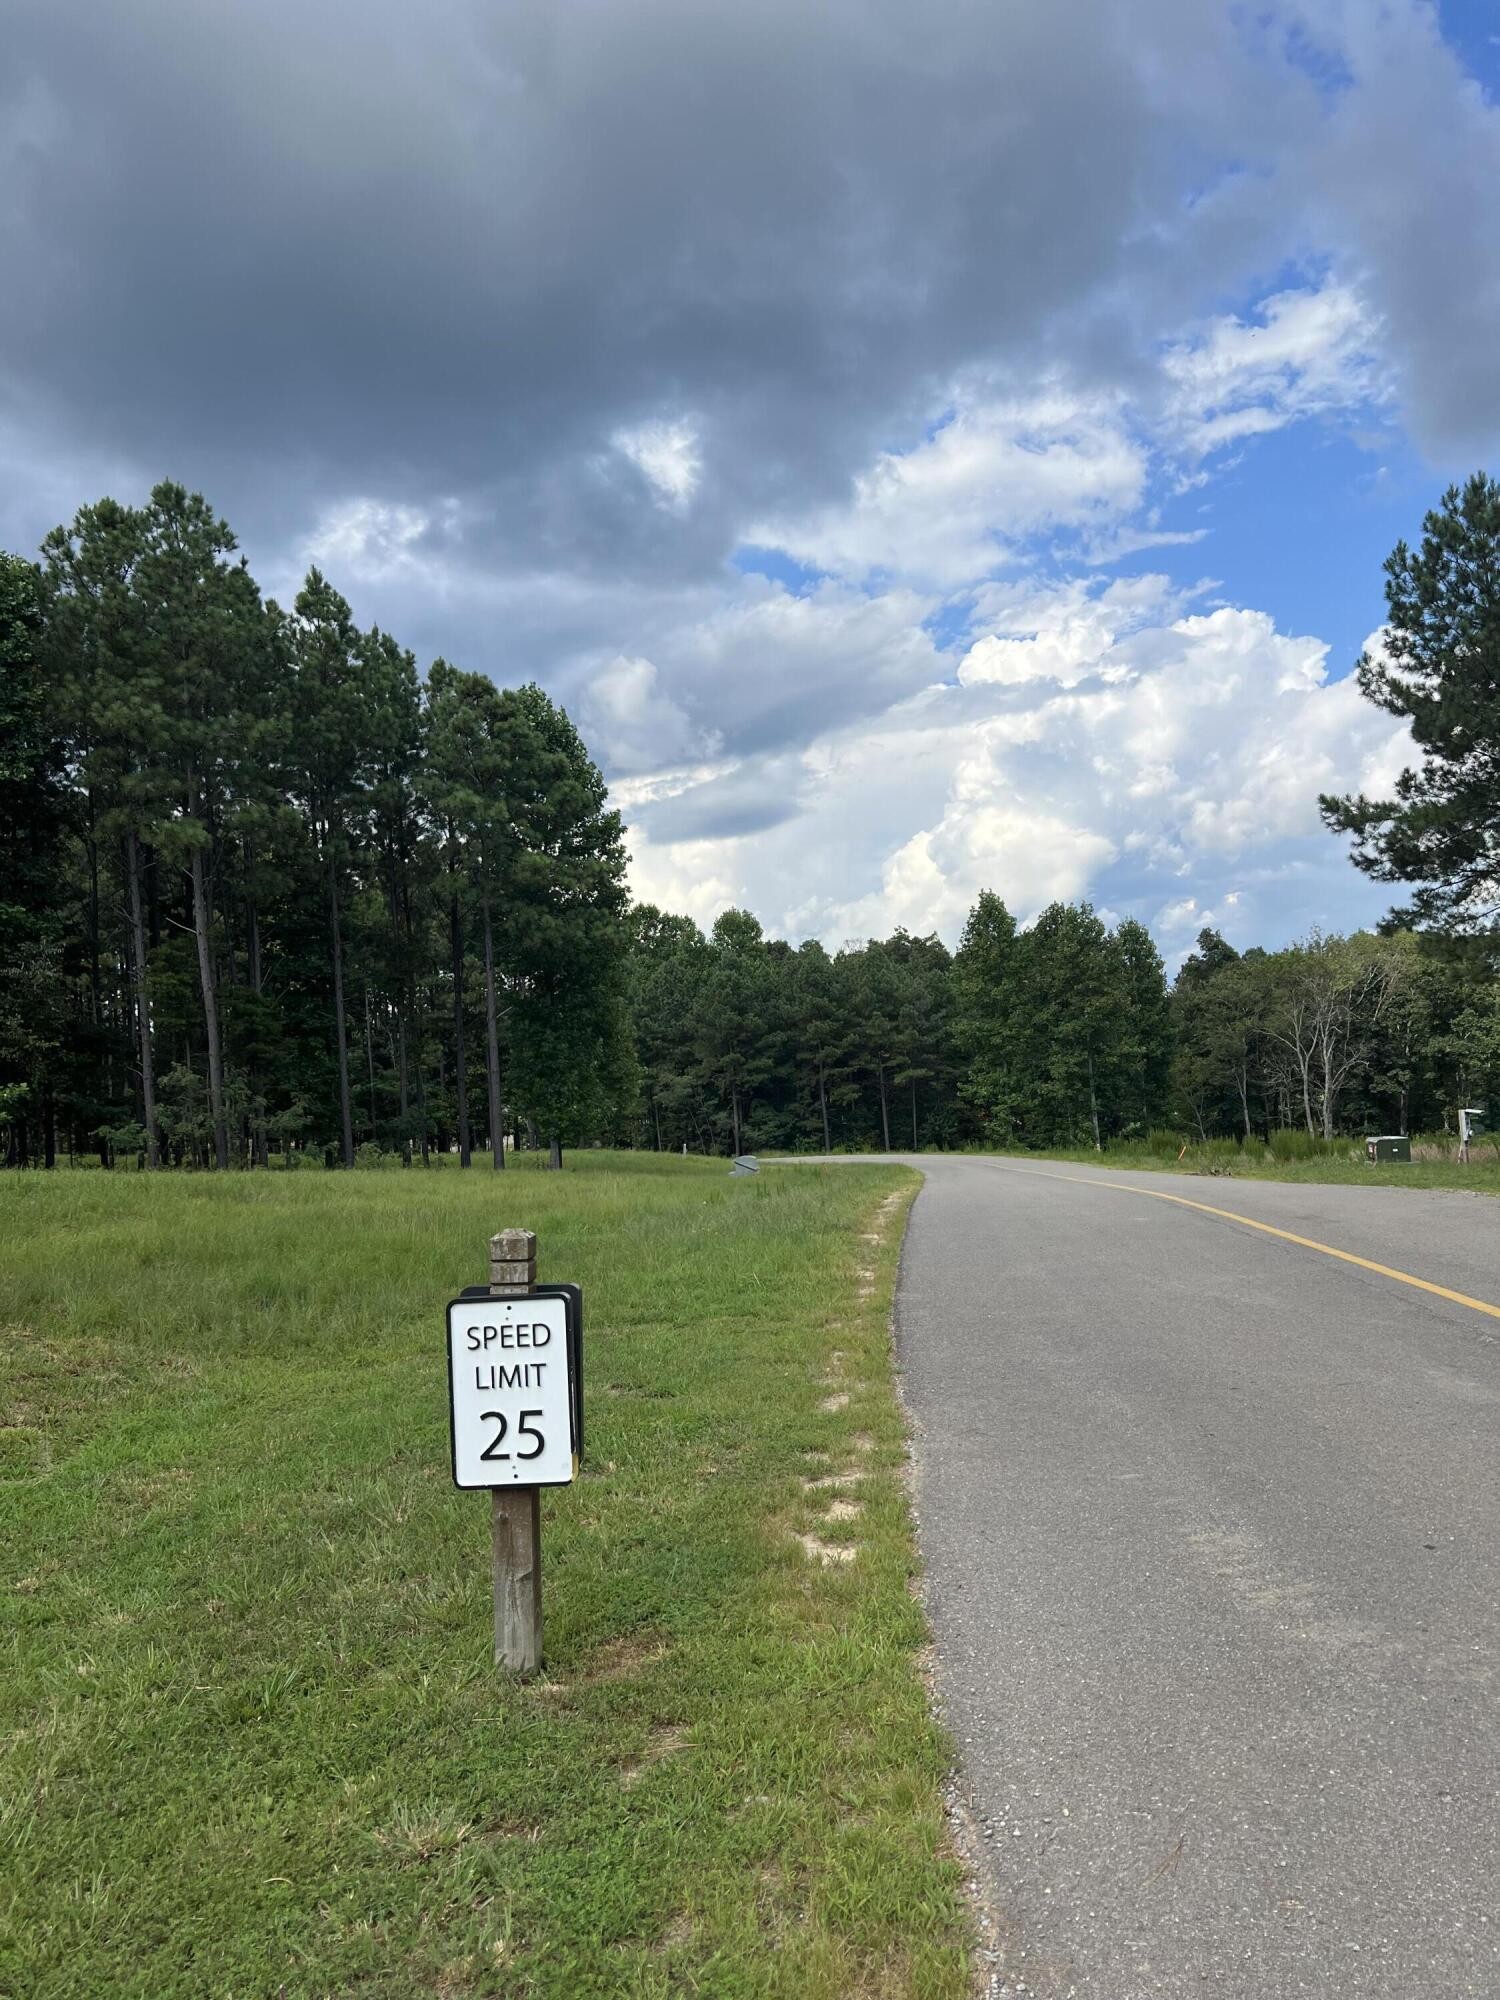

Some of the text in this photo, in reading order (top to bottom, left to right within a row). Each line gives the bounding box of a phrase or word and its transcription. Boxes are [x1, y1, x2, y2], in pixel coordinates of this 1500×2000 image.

[467, 1323, 551, 1351] SPEED
[475, 1363, 547, 1390] LIMIT
[479, 1409, 545, 1461] 25
